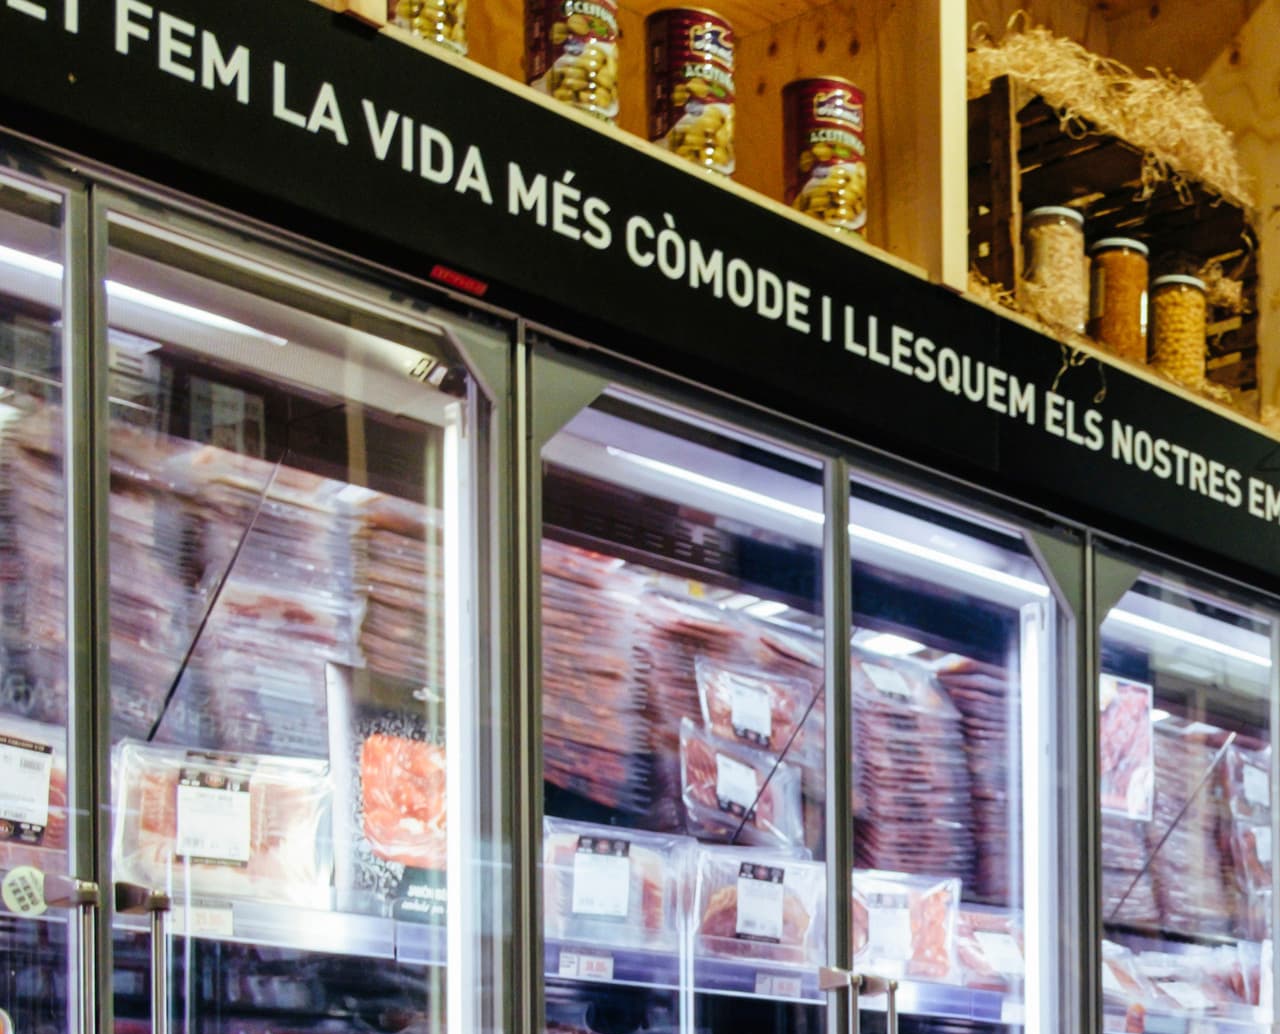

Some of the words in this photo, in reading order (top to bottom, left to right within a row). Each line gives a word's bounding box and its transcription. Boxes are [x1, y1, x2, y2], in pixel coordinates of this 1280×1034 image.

[115, 0, 250, 105] FEM
[273, 61, 349, 146] LA
[361, 99, 493, 205] VIDA
[508, 162, 612, 250] MÉS
[626, 212, 811, 334] CÒMODE
[822, 295, 831, 342] I
[844, 305, 1035, 425] LLESQUEM
[1045, 391, 1104, 451] ELS
[1111, 419, 1243, 508] NOSTRES
